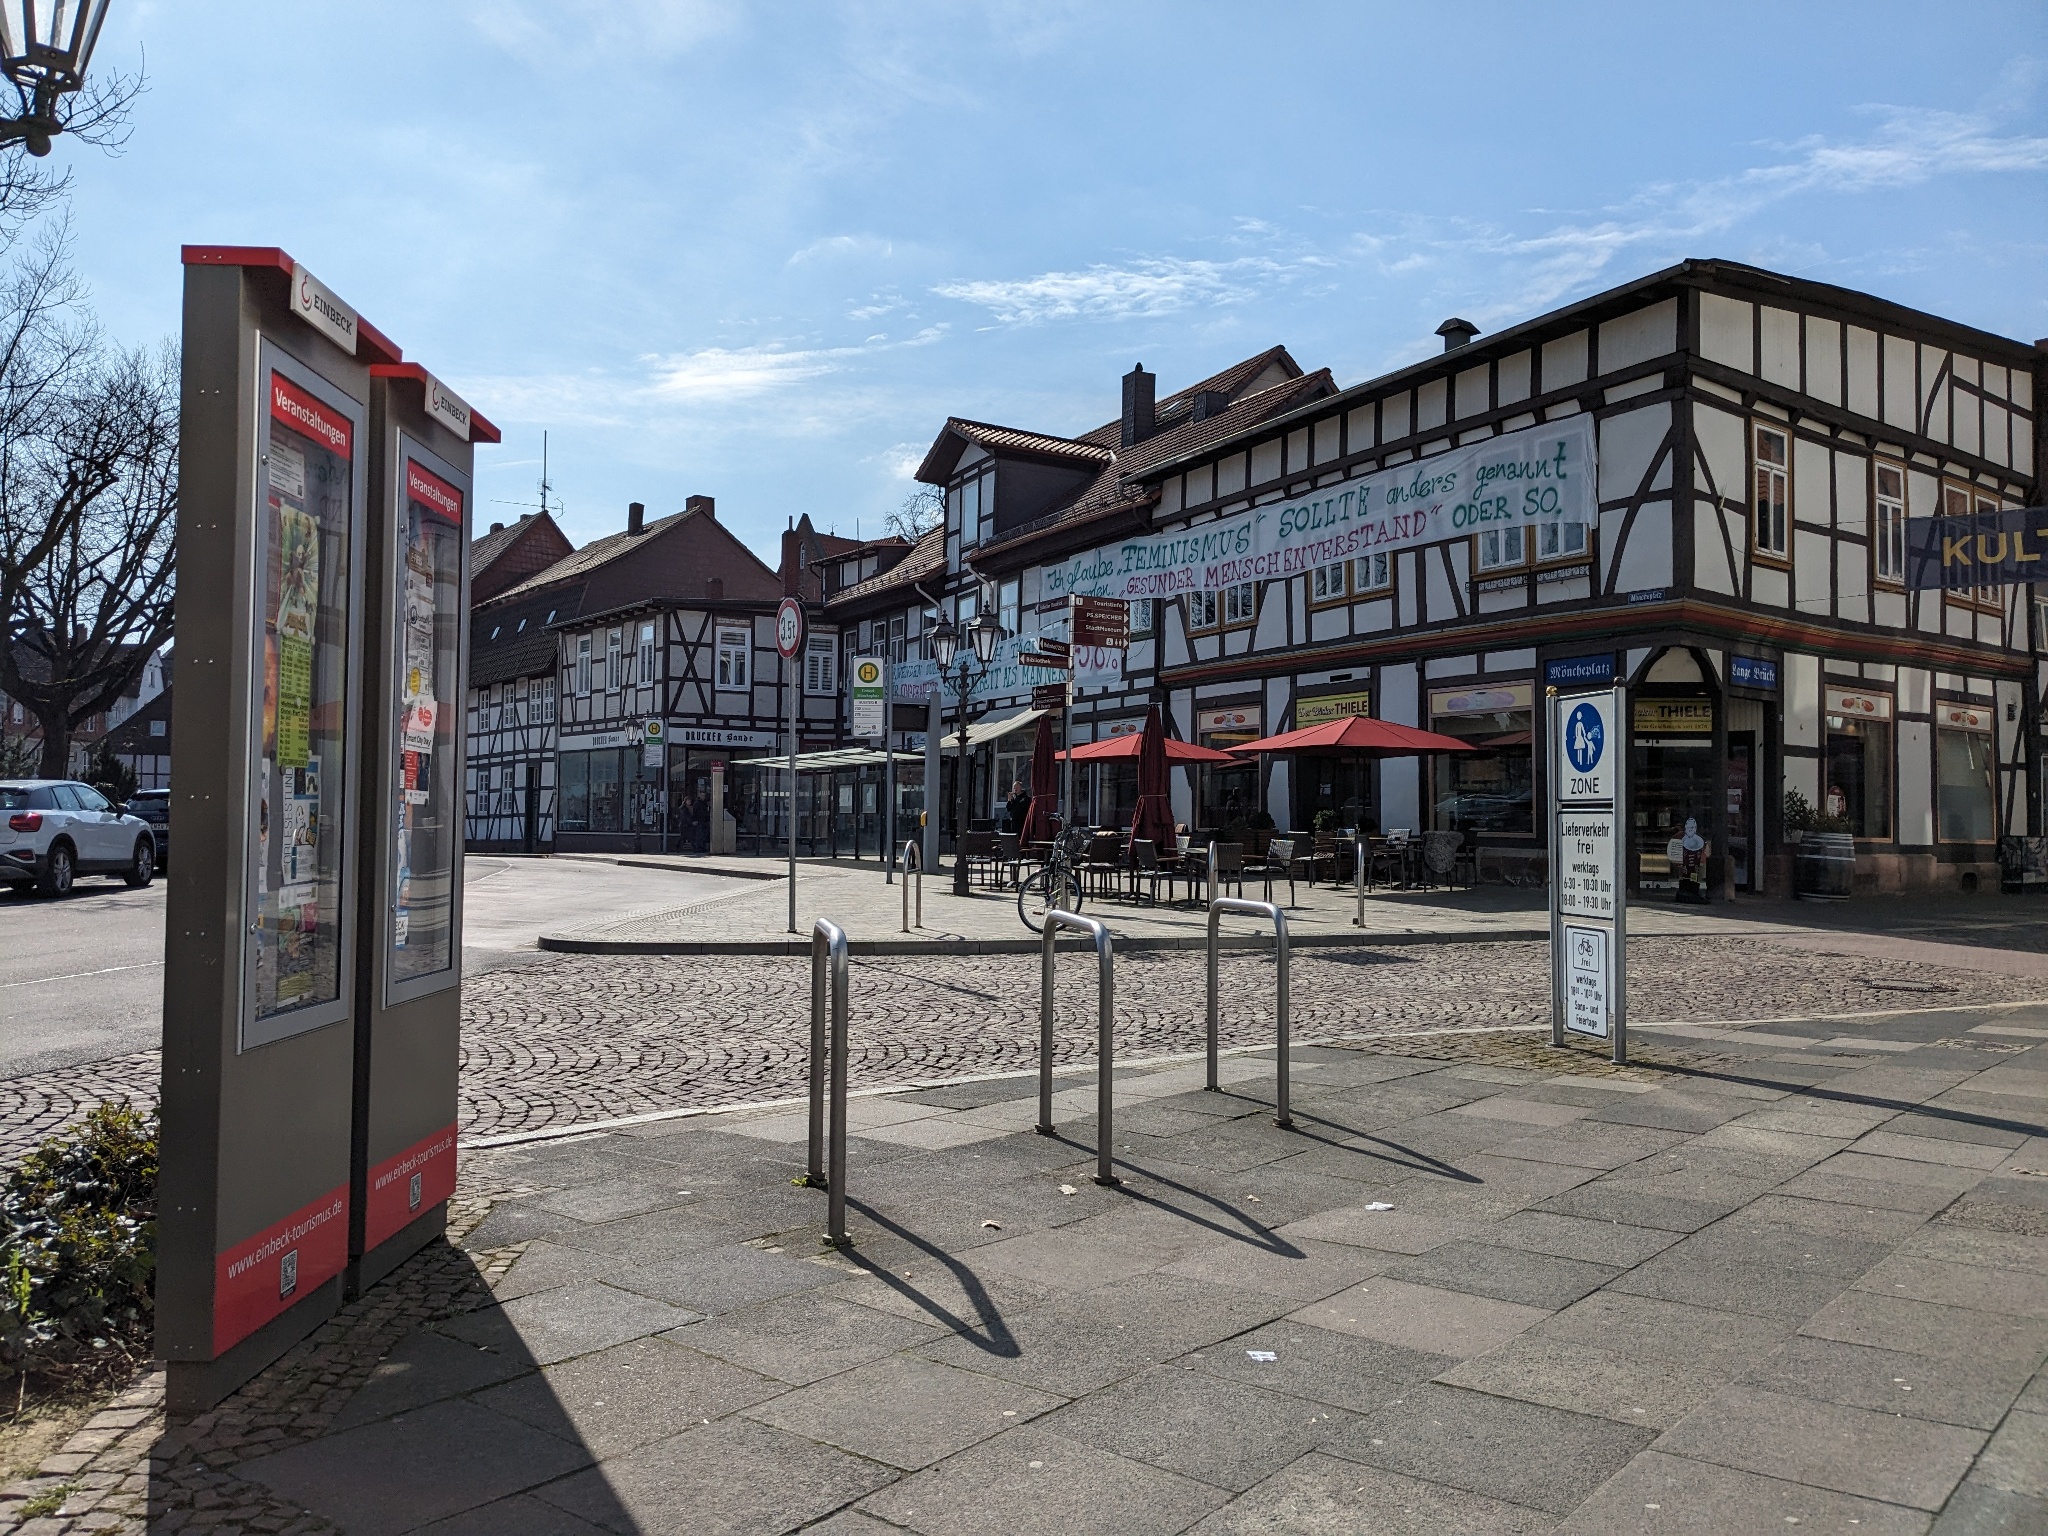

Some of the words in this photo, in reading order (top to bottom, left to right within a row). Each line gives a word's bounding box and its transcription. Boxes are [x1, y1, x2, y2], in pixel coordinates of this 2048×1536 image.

[313, 294, 352, 335] EINBECK
[275, 387, 346, 447] Veranstaltungen
[441, 396, 467, 425] EINBECK
[409, 471, 458, 513] Veranstaltungen
[1279, 486, 1370, 538] SOLLTE
[1386, 470, 1457, 505] anders
[1473, 441, 1567, 500] genannt
[1452, 496, 1512, 529] ODER
[1522, 487, 1562, 517] SO.
[1942, 529, 2048, 567] KUL
[1549, 662, 1610, 680] Möncheplatz
[1335, 701, 1368, 715] THIELE
[1658, 705, 1710, 718] THIELE
[685, 731, 722, 742] DRUCKER
[1570, 777, 1600, 794] ZONE
[1561, 821, 1610, 838] Lieferverkehr
[1577, 838, 1594, 854] frei
[1572, 861, 1599, 877] werktags
[1563, 877, 1576, 890] 6:30
[1582, 878, 1599, 892] 10:30
[1600, 879, 1612, 893] Uhr
[1561, 894, 1576, 907] 18:00
[1582, 895, 1599, 909] 19:30
[1600, 897, 1612, 911] Uhr
[1575, 975, 1597, 989] werktags
[1589, 1004, 1599, 1015] und
[1575, 1014, 1598, 1030] Feiertage
[375, 1135, 453, 1190] www.einbeck-tourismus.de
[228, 1199, 342, 1280] www.einbeck-tourismus.de
